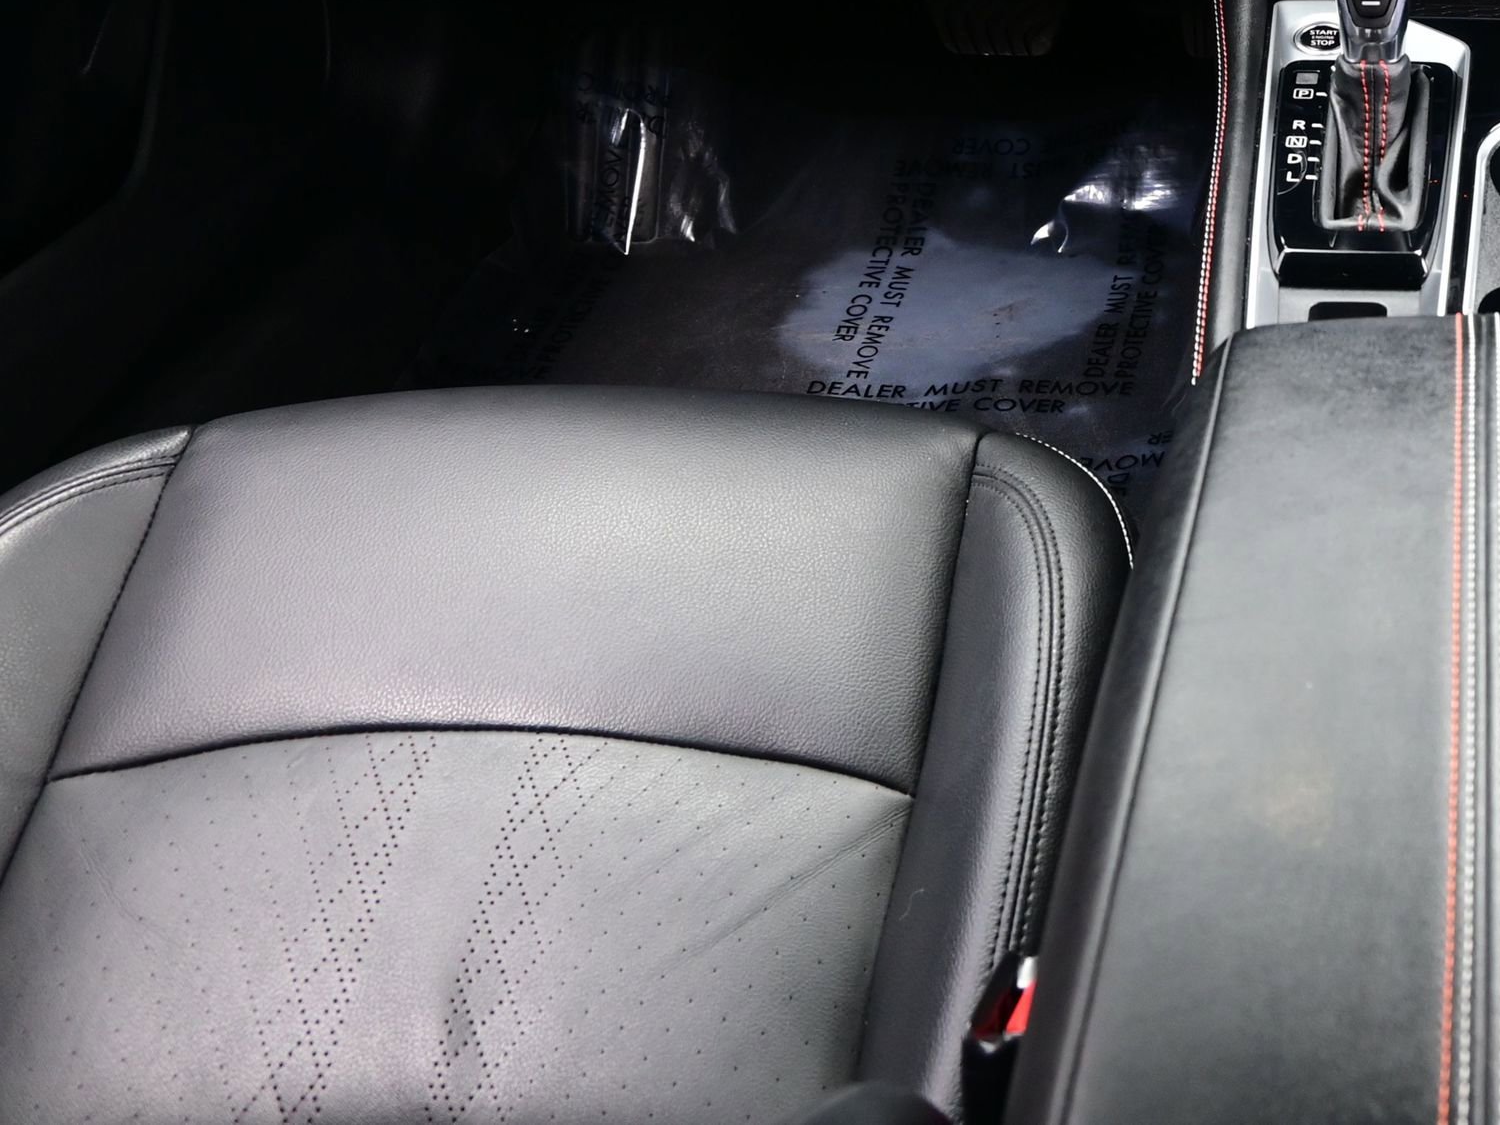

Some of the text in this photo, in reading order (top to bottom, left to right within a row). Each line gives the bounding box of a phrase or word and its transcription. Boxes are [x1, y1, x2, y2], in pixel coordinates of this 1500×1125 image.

[1292, 119, 1306, 131] R
[1287, 153, 1302, 164] D
[1286, 171, 1300, 182] L
[832, 182, 907, 342] PROTECTIVE COVER
[846, 182, 937, 380] DEALER MUST REMOVE
[1083, 322, 1119, 378] DEALER
[1104, 274, 1133, 314] MUST
[1115, 291, 1157, 378] PROTECTIVE
[806, 378, 1135, 398] DEALER MUST REMOVE
[972, 397, 1066, 413] COVER
